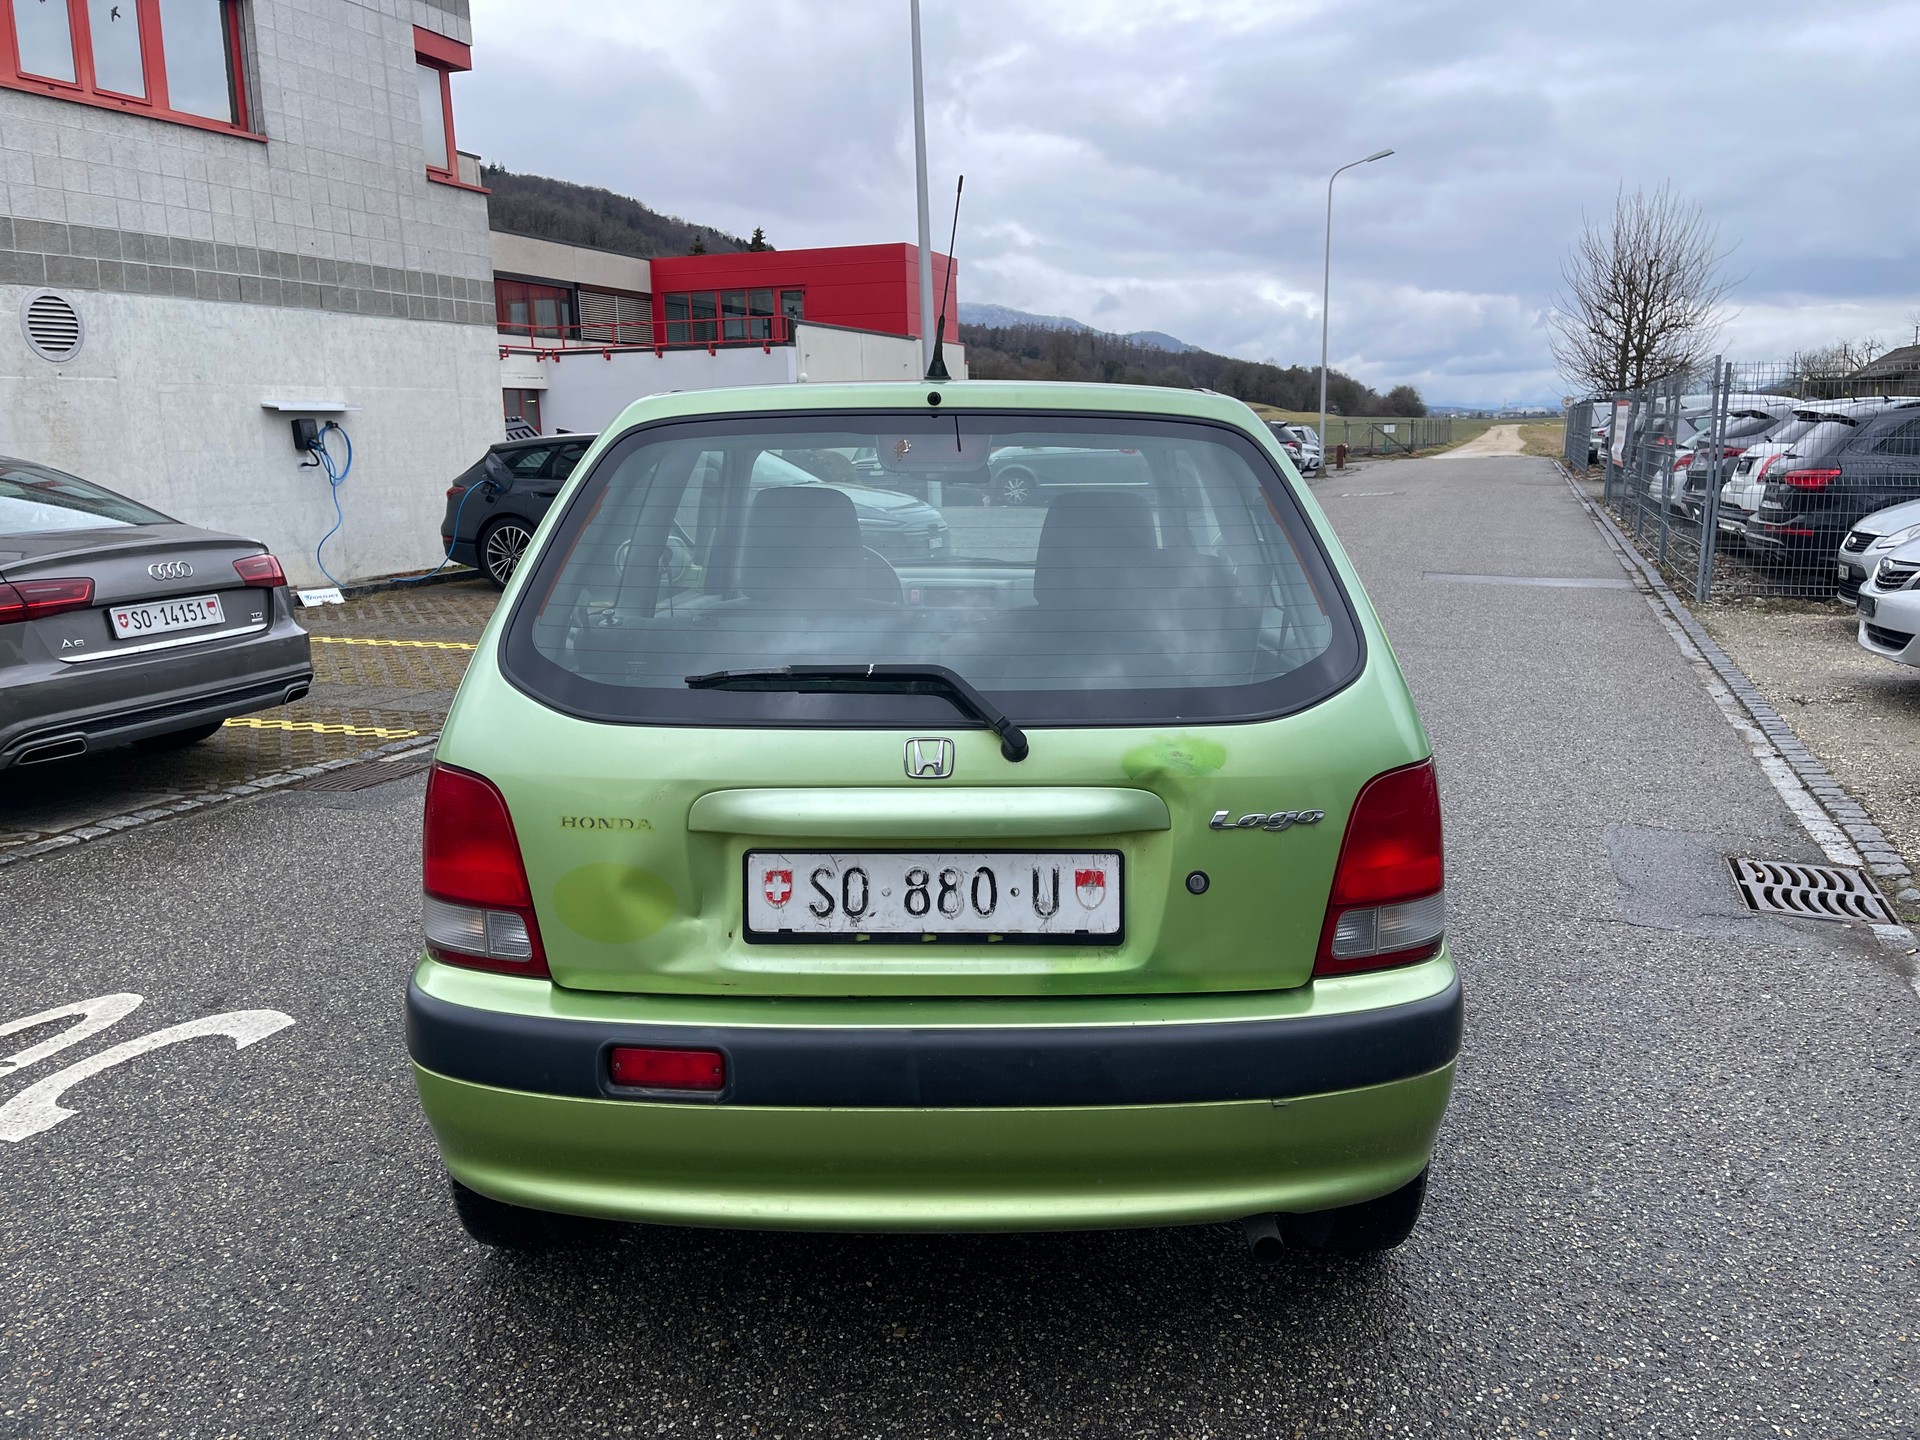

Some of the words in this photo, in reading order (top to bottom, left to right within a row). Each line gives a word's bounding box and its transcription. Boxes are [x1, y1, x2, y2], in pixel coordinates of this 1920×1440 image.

[61, 638, 85, 650] A6
[561, 816, 653, 830] HONDA
[1209, 809, 1325, 831] Logo
